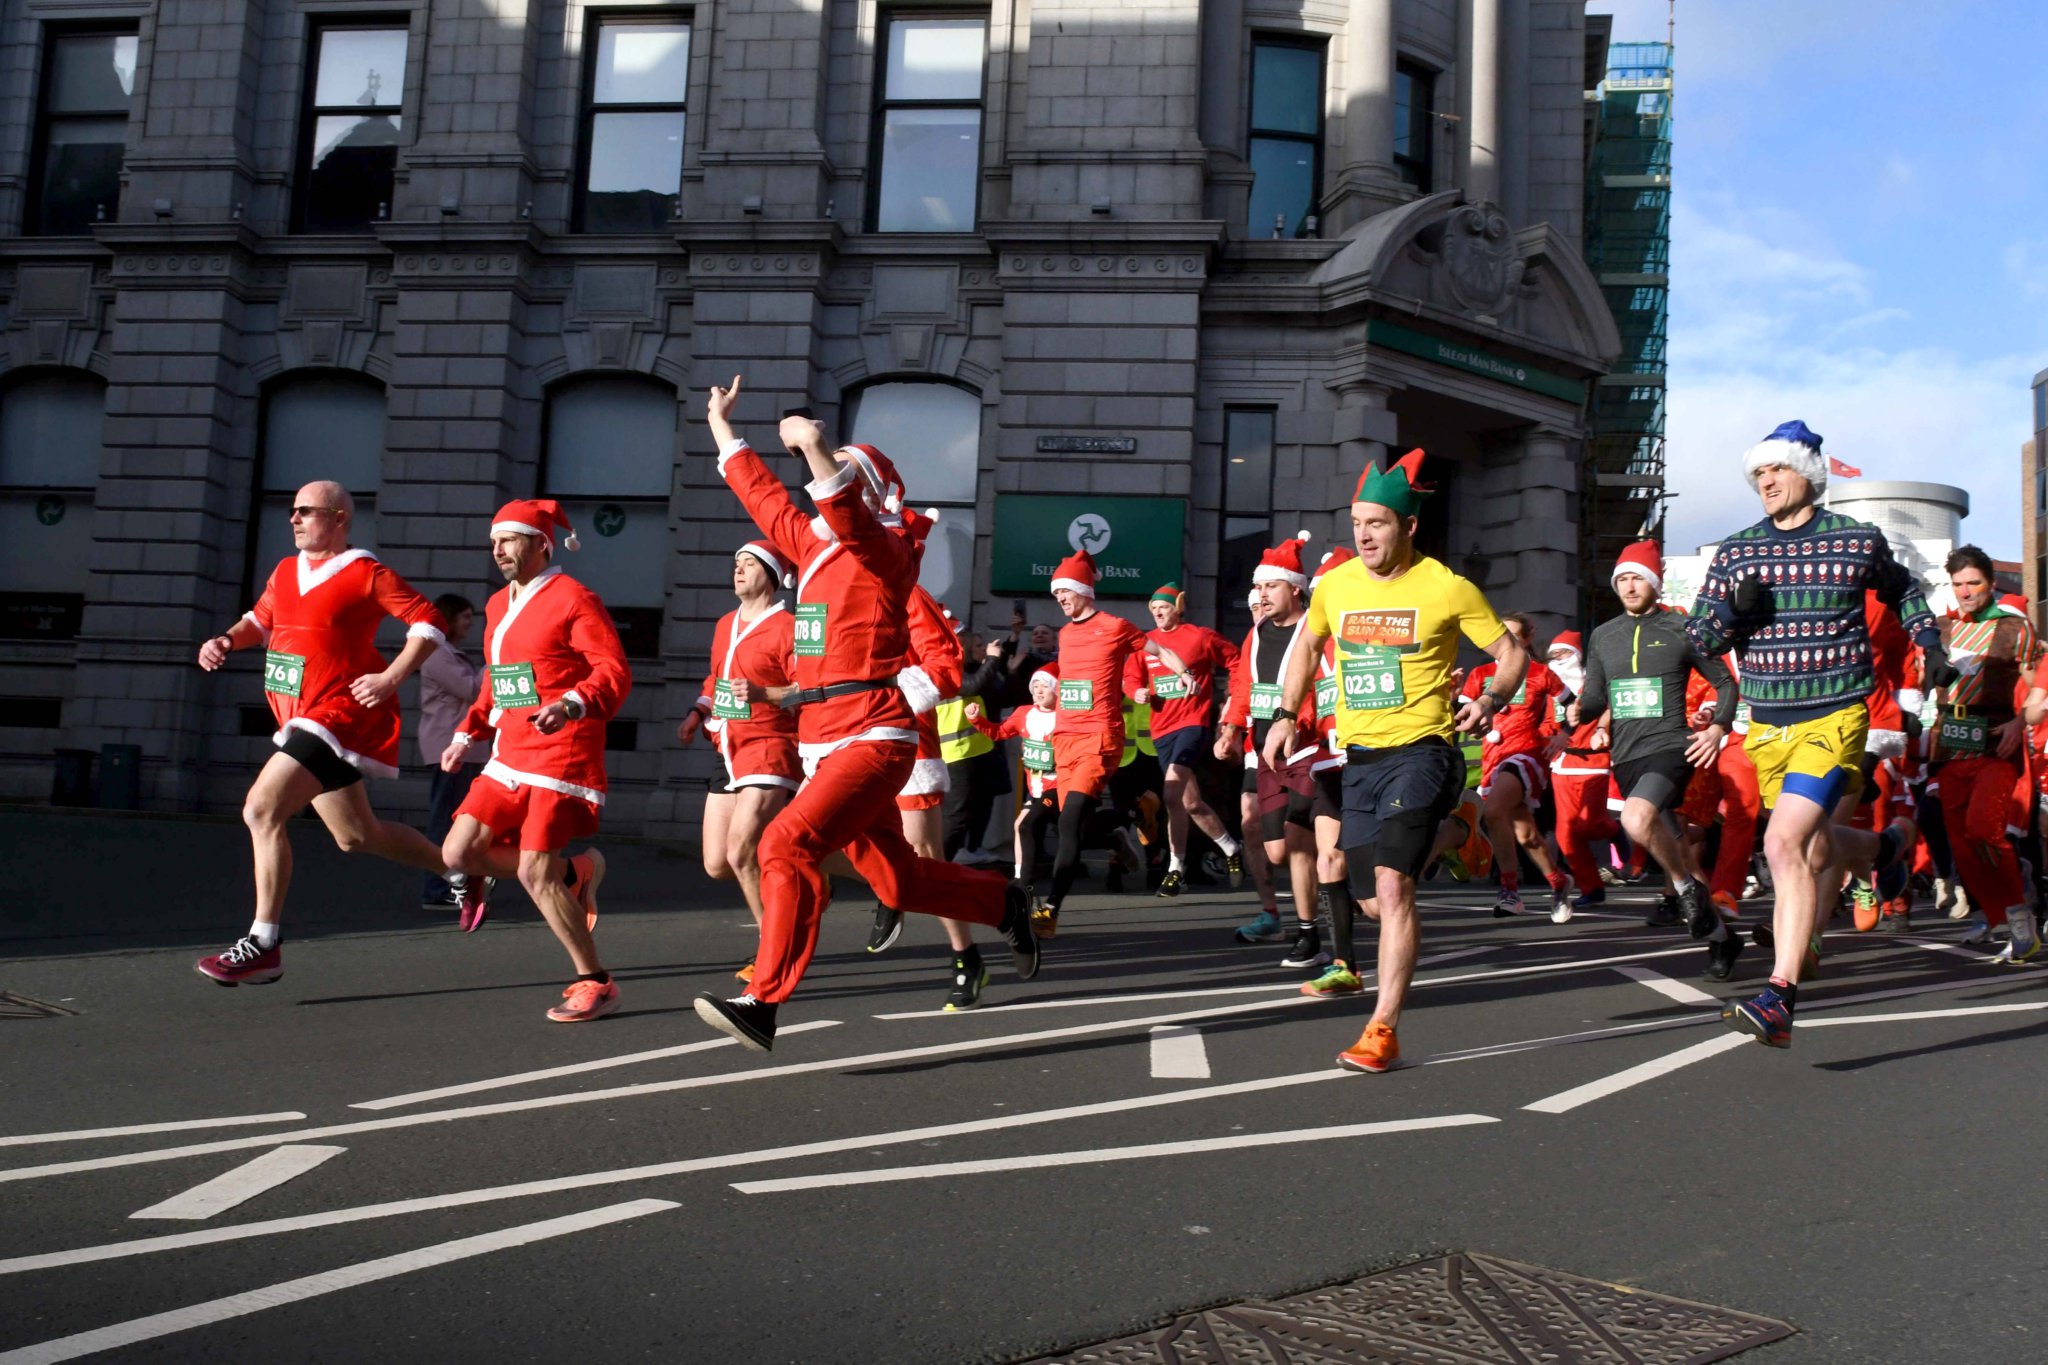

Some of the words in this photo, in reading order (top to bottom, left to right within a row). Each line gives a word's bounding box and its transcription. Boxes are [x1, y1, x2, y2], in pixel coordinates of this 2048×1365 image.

[1105, 565, 1141, 578] BANK
[1347, 615, 1383, 625] RACE
[1385, 616, 1411, 627] THE
[1346, 625, 1376, 636] SUN
[1379, 627, 1410, 638] 2019
[264, 663, 286, 681] 76
[494, 678, 516, 695] 186
[1156, 682, 1174, 693] 217
[1345, 674, 1376, 695] 023
[1060, 689, 1079, 701] 213
[1318, 688, 1338, 706] 097
[1615, 690, 1642, 707] 133
[1943, 724, 1968, 739] 035
[1024, 746, 1040, 760] 214
